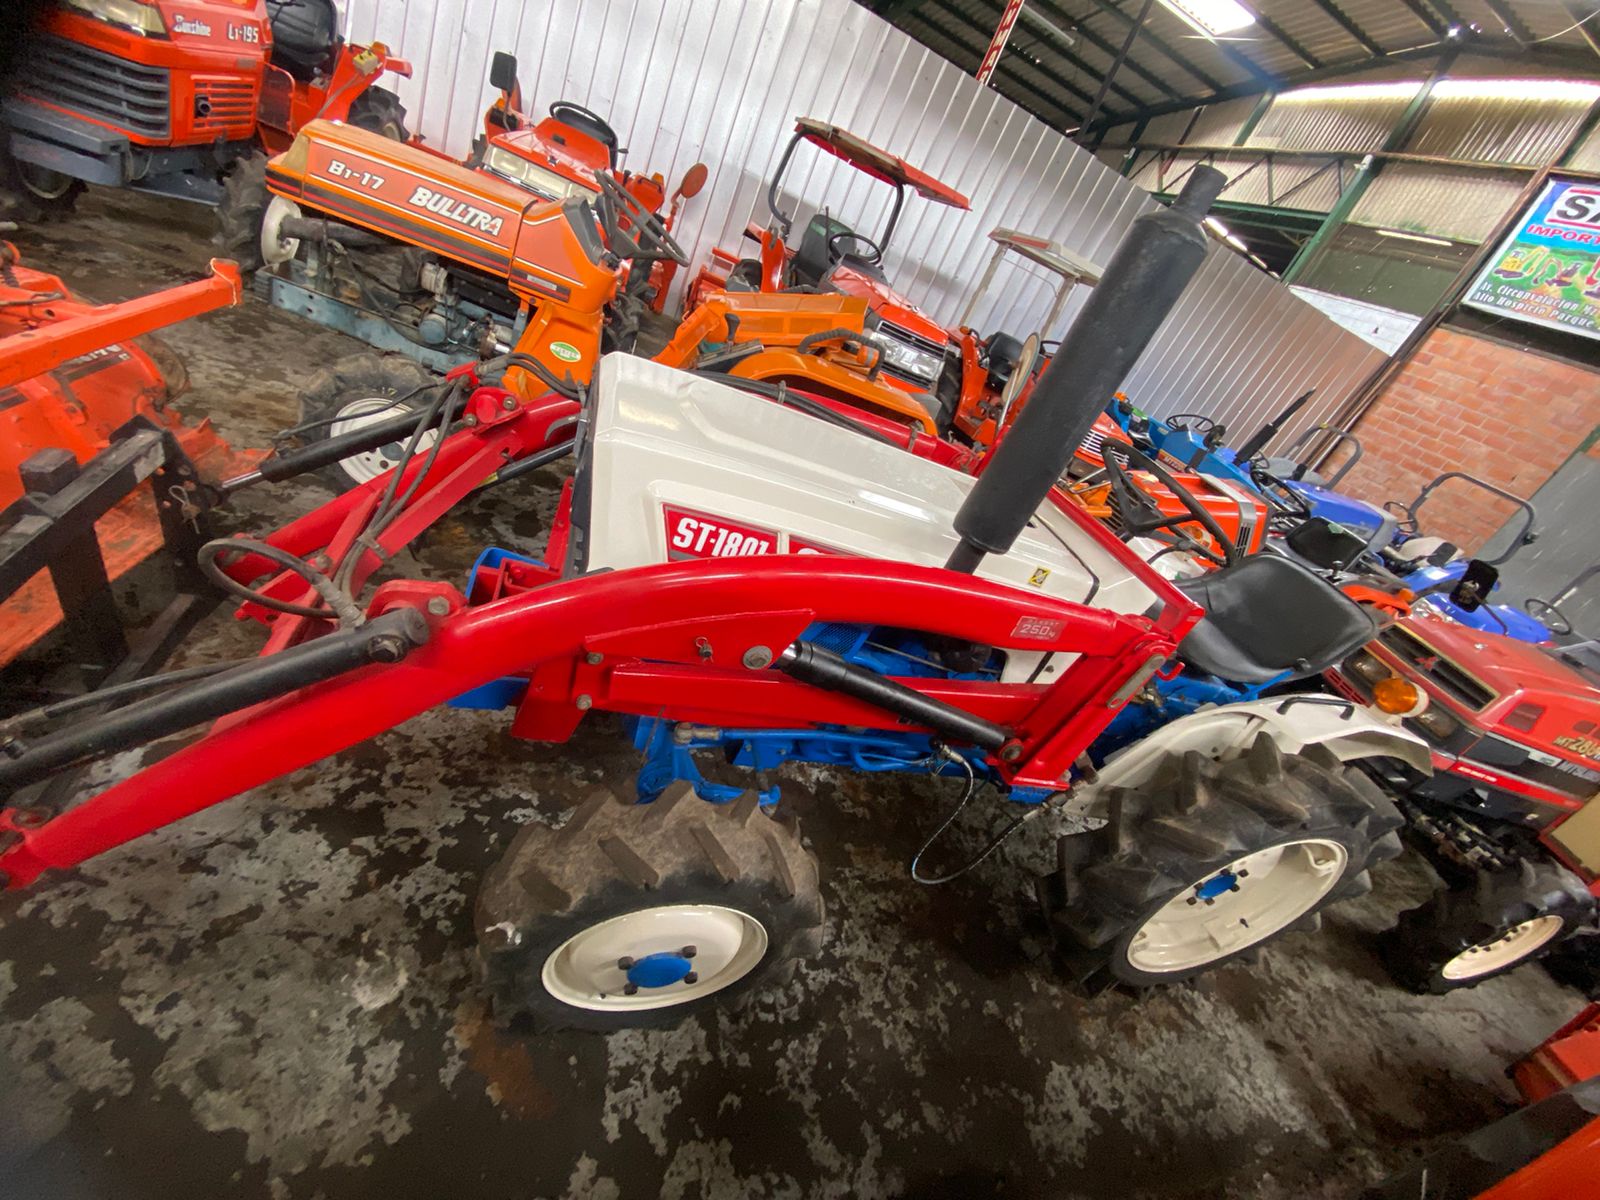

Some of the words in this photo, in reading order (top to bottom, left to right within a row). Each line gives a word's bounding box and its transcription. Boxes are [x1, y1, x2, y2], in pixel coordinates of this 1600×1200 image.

[327, 159, 385, 190] B1-17
[409, 186, 503, 236] BULLTRA
[1473, 291, 1495, 303] Alto
[1496, 295, 1546, 315] Hospicio
[1548, 309, 1595, 328] Parque
